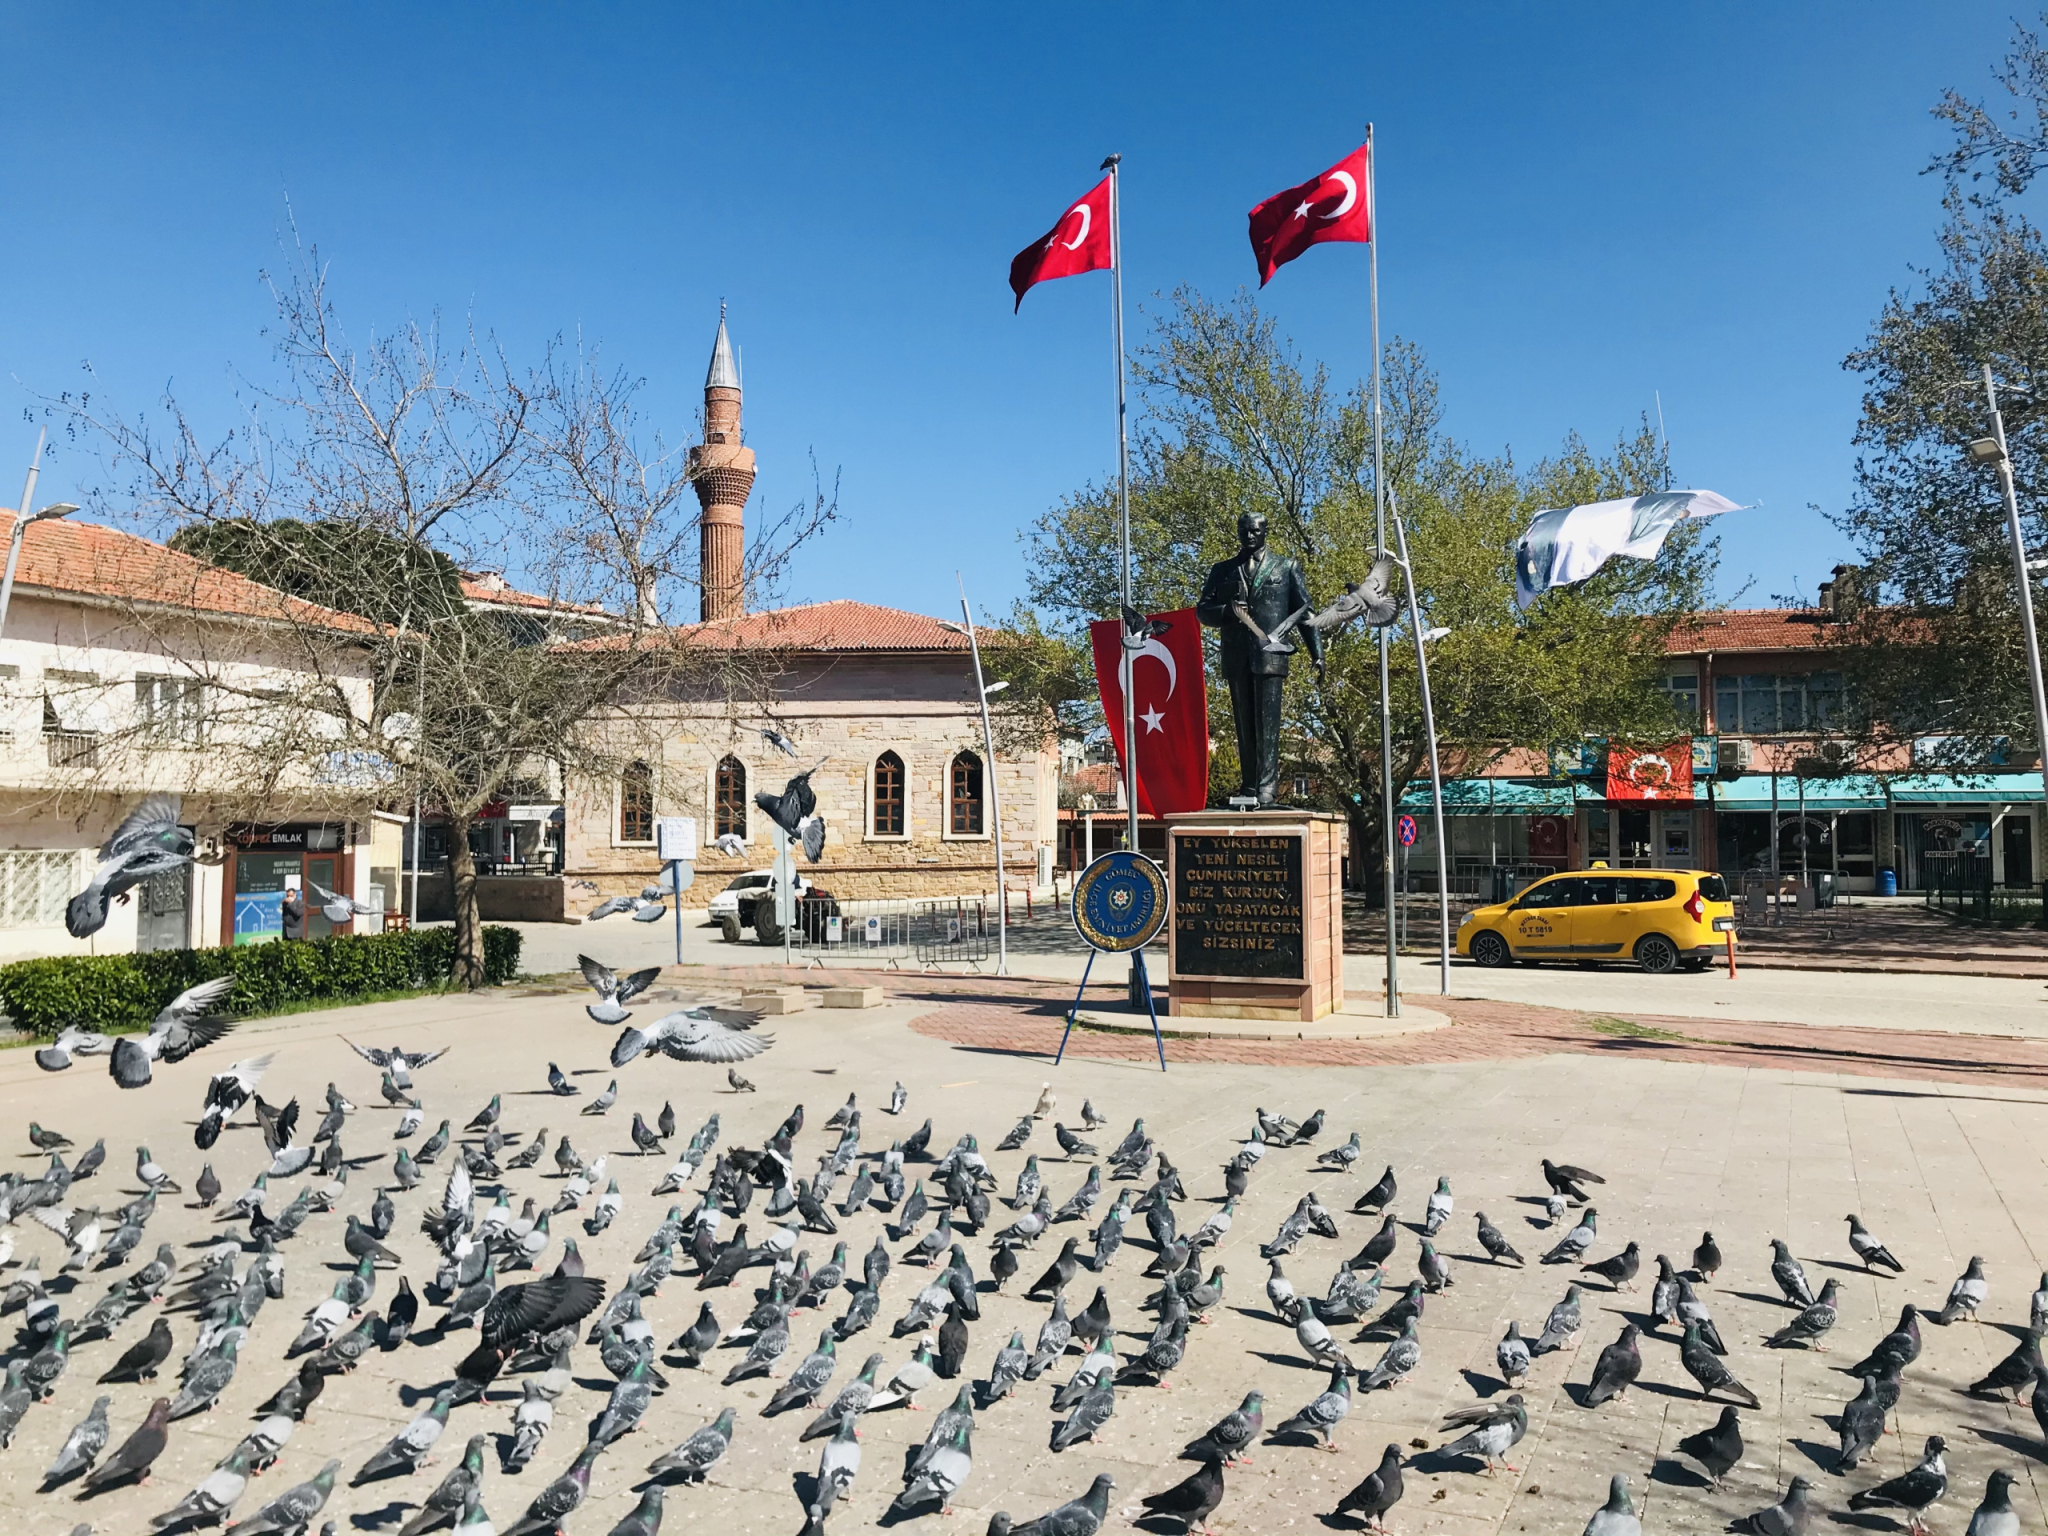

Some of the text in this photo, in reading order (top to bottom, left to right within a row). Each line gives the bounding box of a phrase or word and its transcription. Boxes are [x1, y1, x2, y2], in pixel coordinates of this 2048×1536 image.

[272, 833, 302, 843] EMLAK
[1183, 838, 1201, 848] EY
[1186, 868, 1288, 882] CUMHURİYETİ
[1189, 883, 1214, 898] BİZ
[1176, 902, 1300, 918] ONU YAŞATACAK
[1176, 917, 1301, 934] VE YÜCELTECEK
[1202, 934, 1275, 950] SİZSİNİZ
